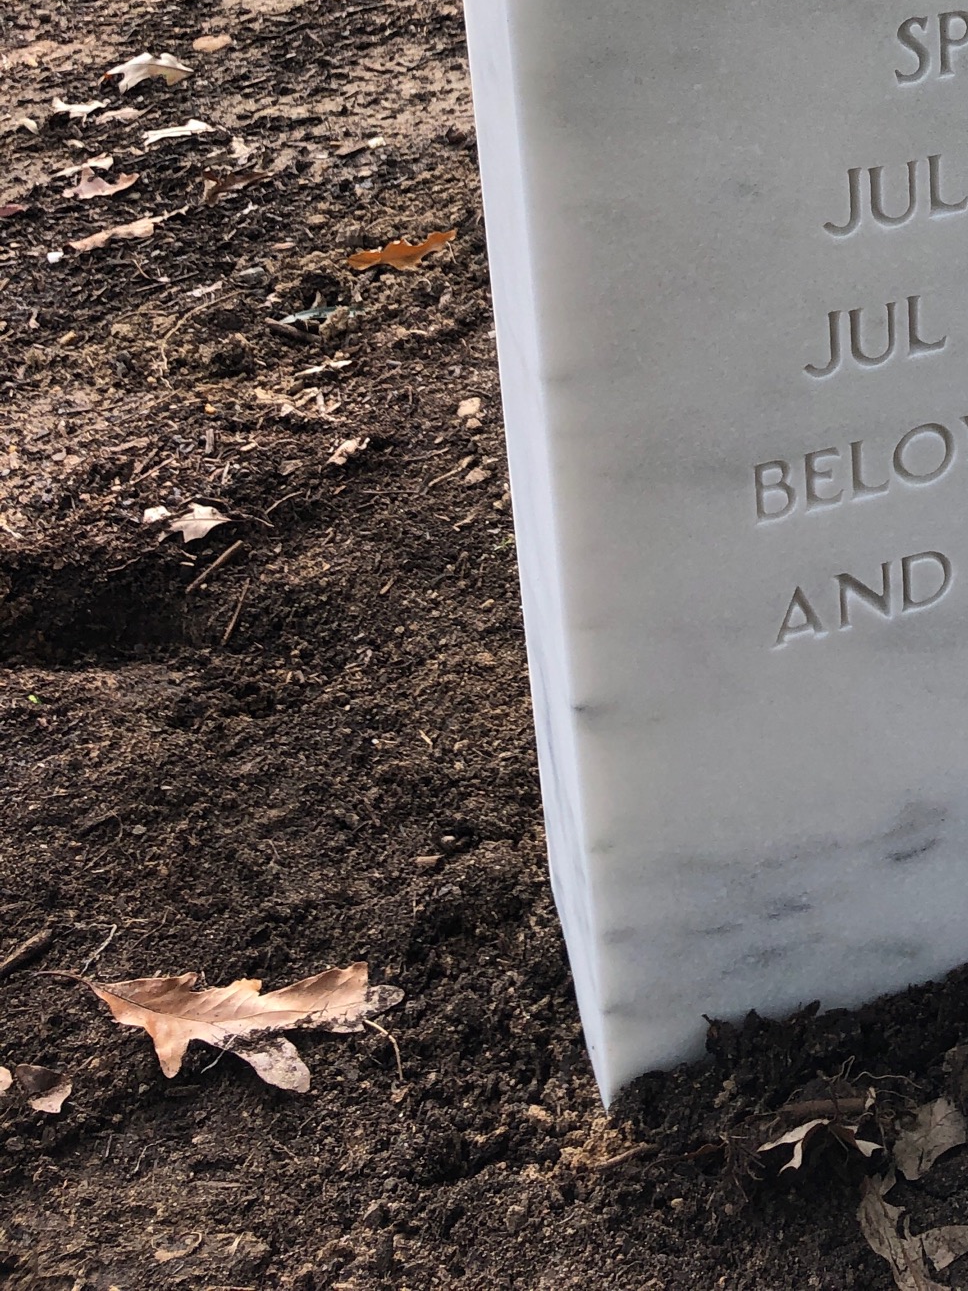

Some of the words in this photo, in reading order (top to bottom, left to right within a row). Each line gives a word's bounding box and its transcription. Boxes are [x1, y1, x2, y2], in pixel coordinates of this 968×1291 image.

[822, 153, 968, 239] JUL
[802, 294, 947, 379] JUL
[771, 549, 954, 650] AND
